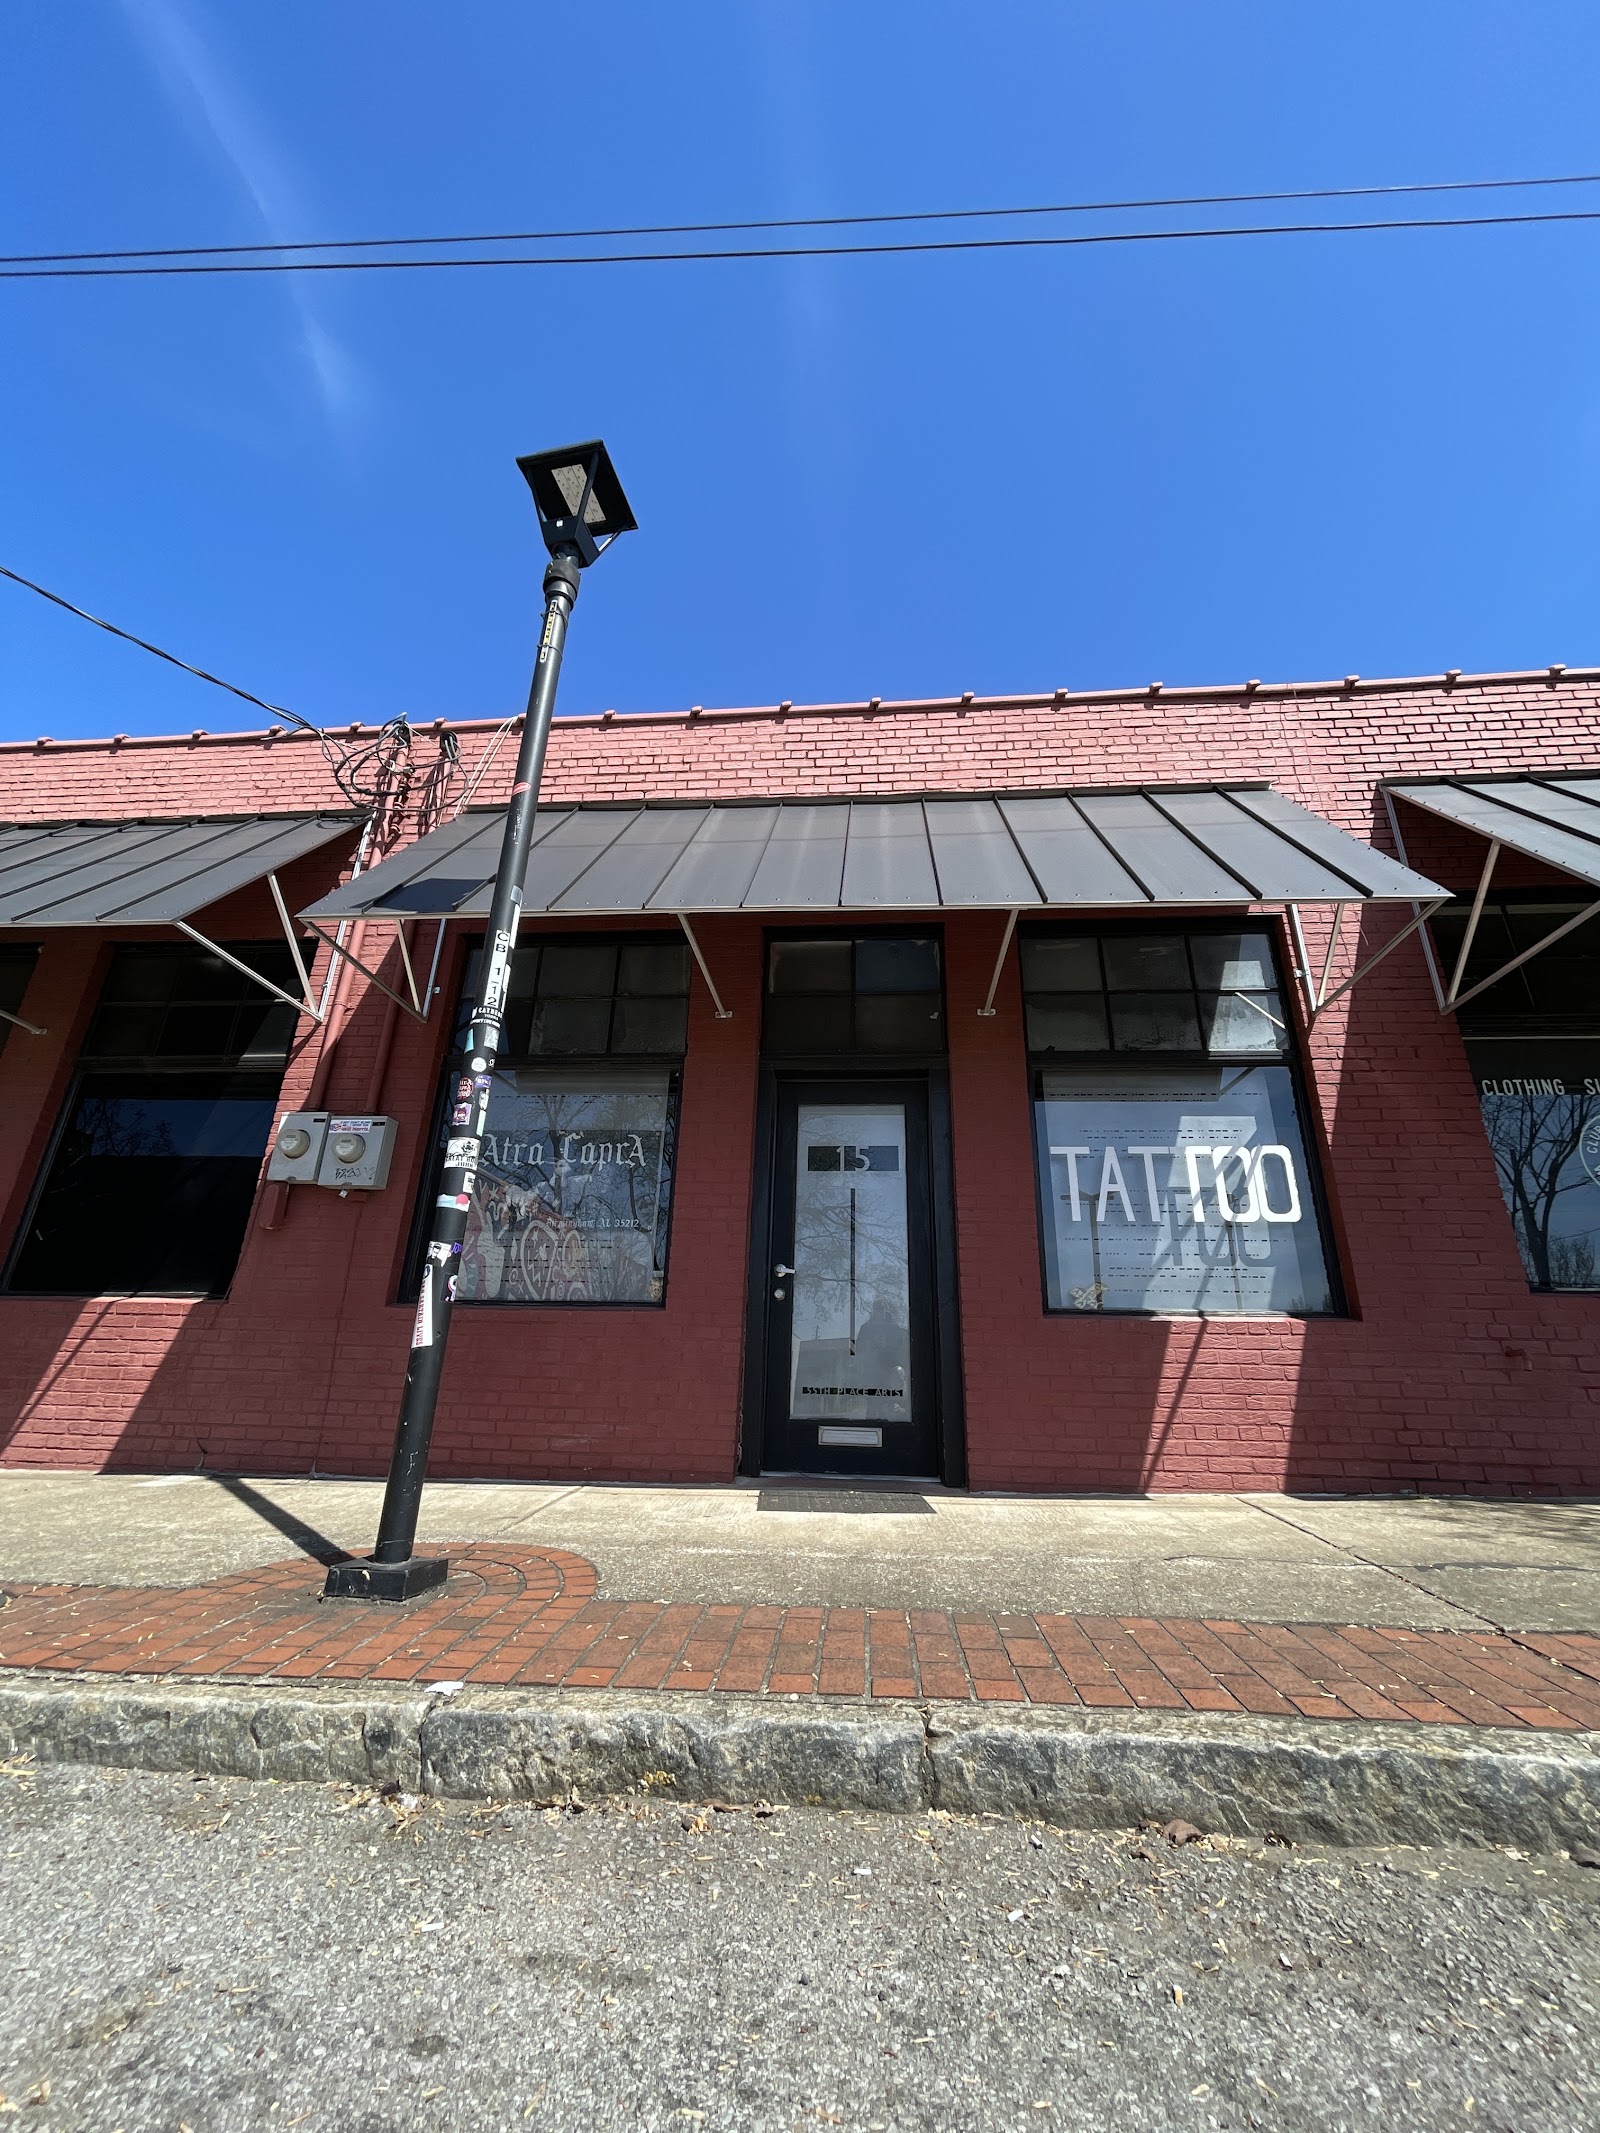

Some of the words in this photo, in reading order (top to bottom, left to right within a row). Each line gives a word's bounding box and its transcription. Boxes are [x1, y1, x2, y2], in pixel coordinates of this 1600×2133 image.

[1481, 1078, 1565, 1096] CLOTHING
[836, 1145, 870, 1172] 15
[1050, 1144, 1303, 1223] TATTOO
[614, 1219, 640, 1228] 35212
[415, 1325, 424, 1346] LIVES
[838, 1388, 869, 1396] PLACE
[875, 1388, 901, 1397] ARTS
